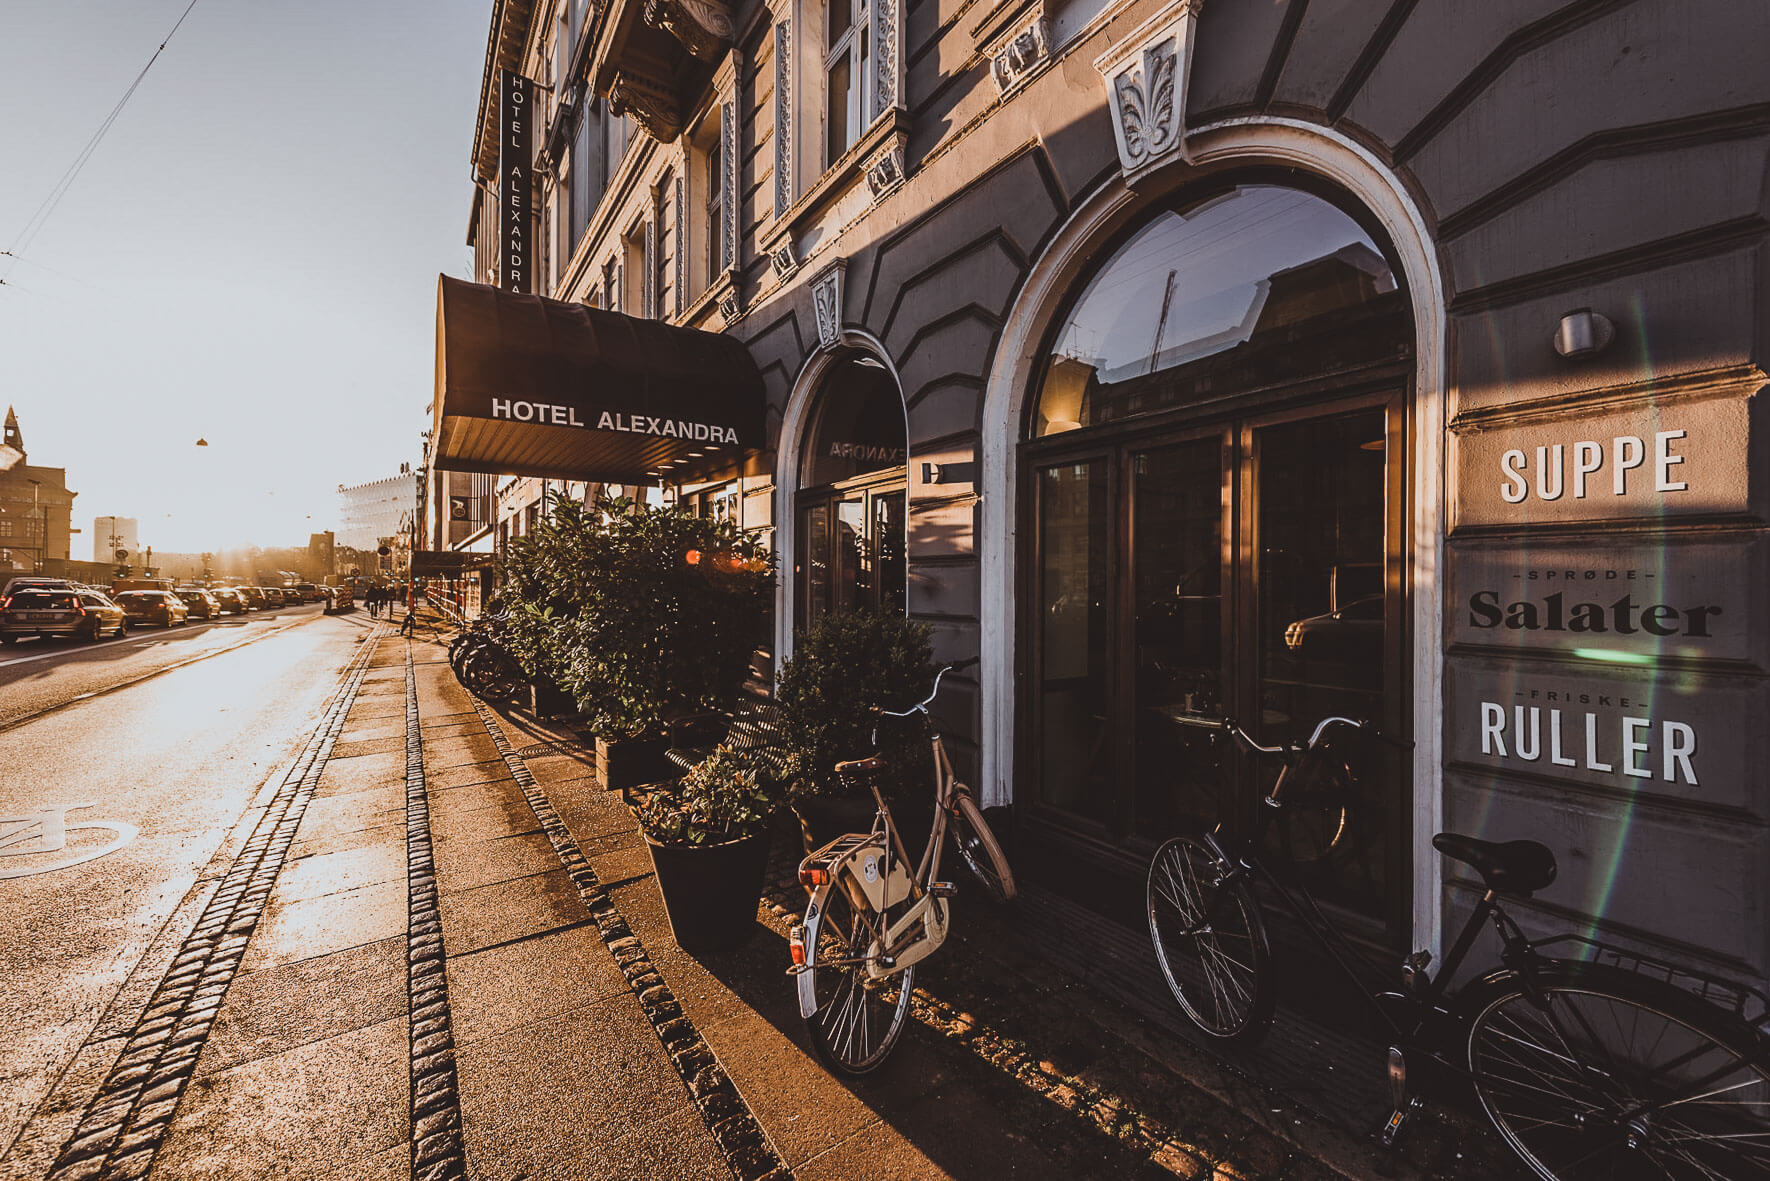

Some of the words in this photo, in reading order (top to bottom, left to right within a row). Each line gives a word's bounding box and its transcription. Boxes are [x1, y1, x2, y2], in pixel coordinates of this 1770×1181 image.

[512, 76, 523, 148] HOTEL
[511, 166, 521, 294] ALEXANDRA
[492, 398, 584, 427] HOTEL
[597, 411, 739, 445] ALEXANDRA
[1501, 429, 1688, 504] SUPPE
[1469, 590, 1723, 638] Salater
[1481, 701, 1699, 786] RULLER
